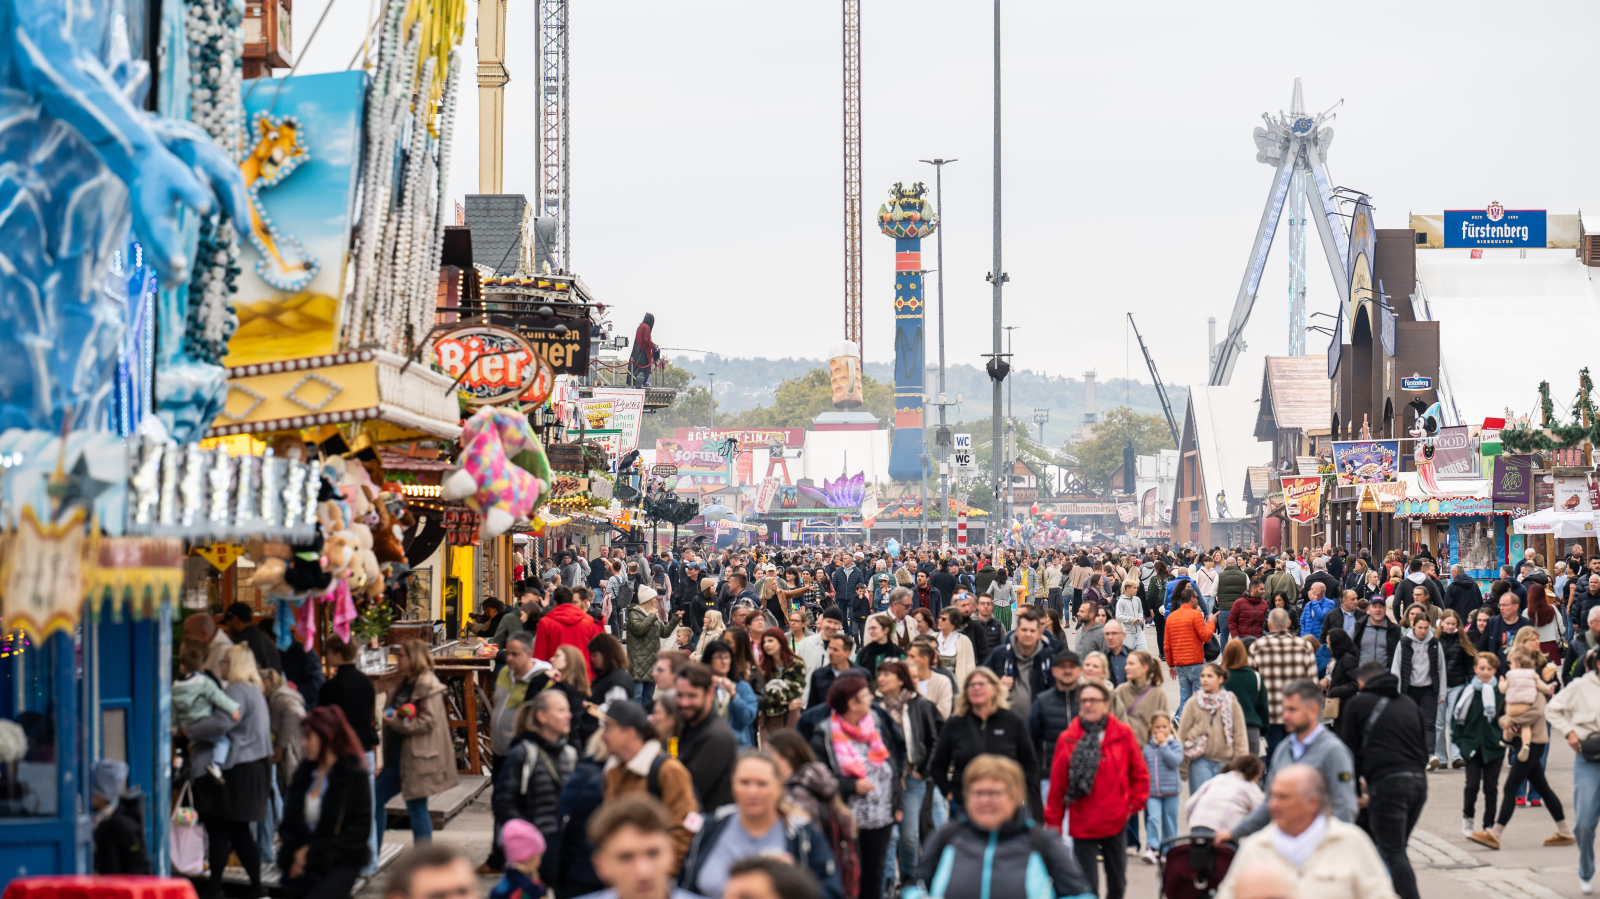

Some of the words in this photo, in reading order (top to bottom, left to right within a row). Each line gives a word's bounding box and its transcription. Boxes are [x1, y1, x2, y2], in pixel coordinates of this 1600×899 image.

[436, 337, 530, 386] Bier
[584, 402, 612, 411] Angebot!
[614, 413, 634, 422] ghetti
[956, 436, 970, 446] WC
[673, 450, 725, 463] SOFTEIS
[955, 454, 970, 464] WC
[551, 479, 580, 496] zza
[1286, 481, 1318, 498] Churros
[1060, 503, 1111, 514] Willkommen
